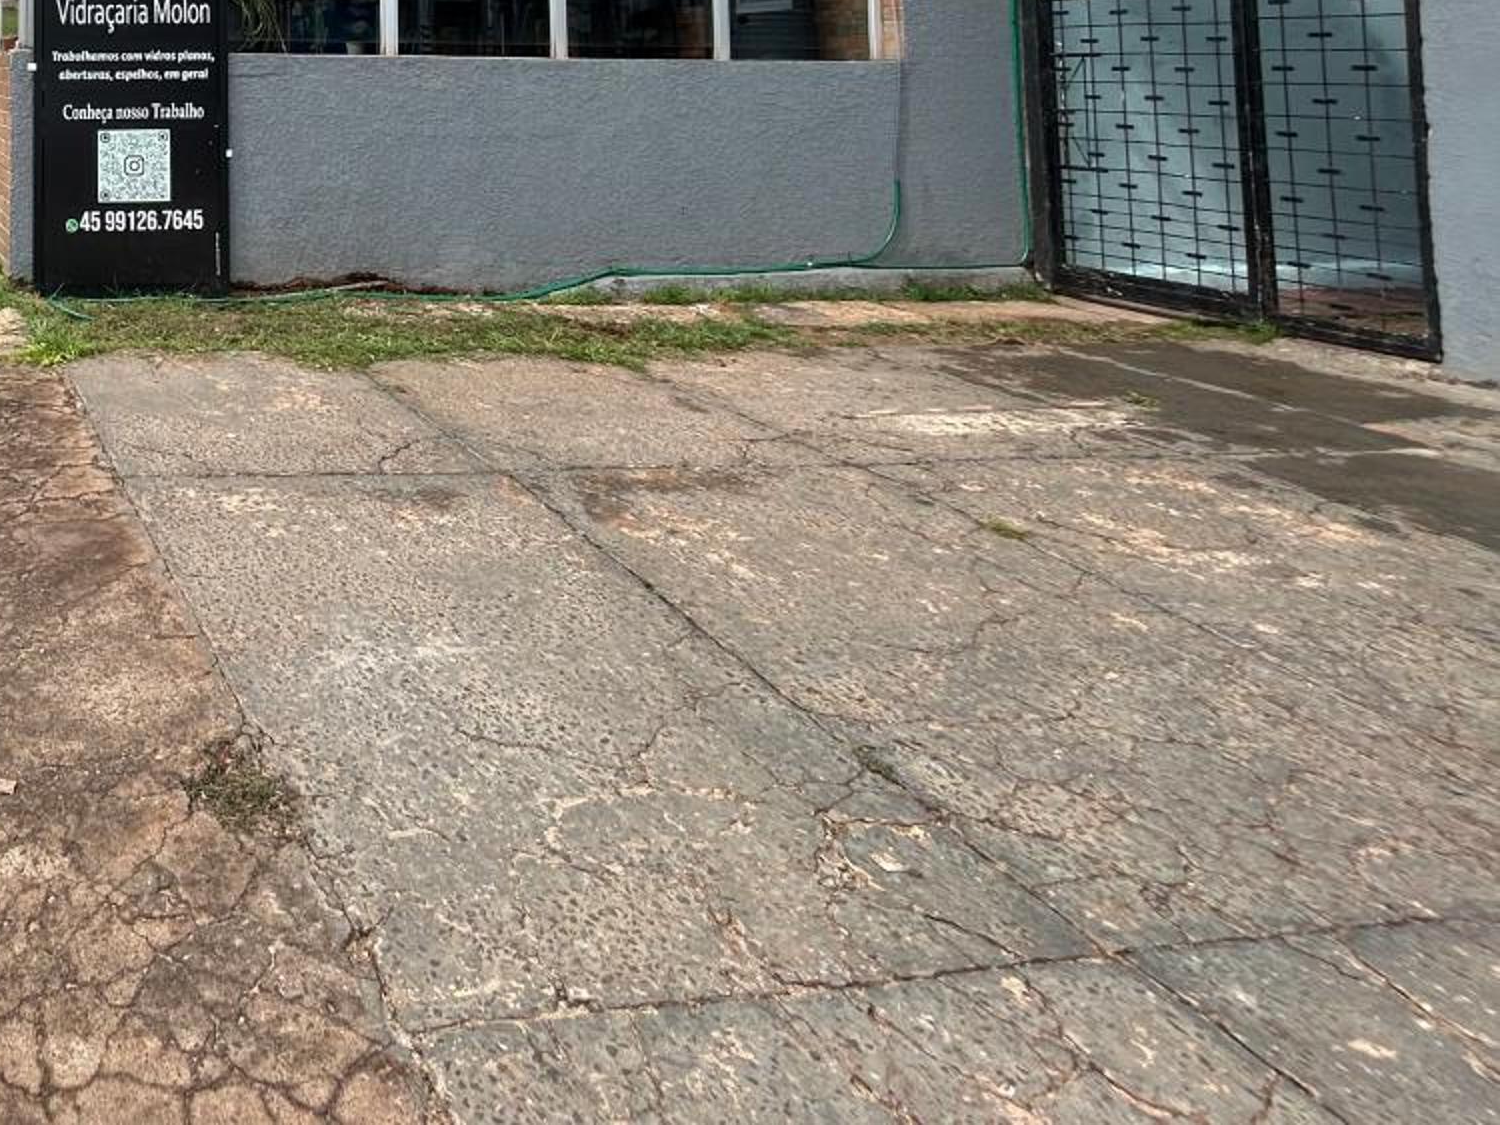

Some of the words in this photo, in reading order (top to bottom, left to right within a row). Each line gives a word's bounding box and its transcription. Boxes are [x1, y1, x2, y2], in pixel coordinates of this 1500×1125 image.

[51, 49, 119, 63] Trabalhamos
[120, 52, 143, 62] com
[144, 49, 176, 62] vidros
[115, 68, 162, 82] espelhos,
[164, 70, 181, 81] em
[181, 67, 209, 82] geral
[62, 102, 113, 124] Conheça
[115, 105, 149, 120] nosso
[151, 101, 205, 119] Trabalho
[79, 210, 100, 233] 45
[104, 208, 204, 233] 99126.7645
